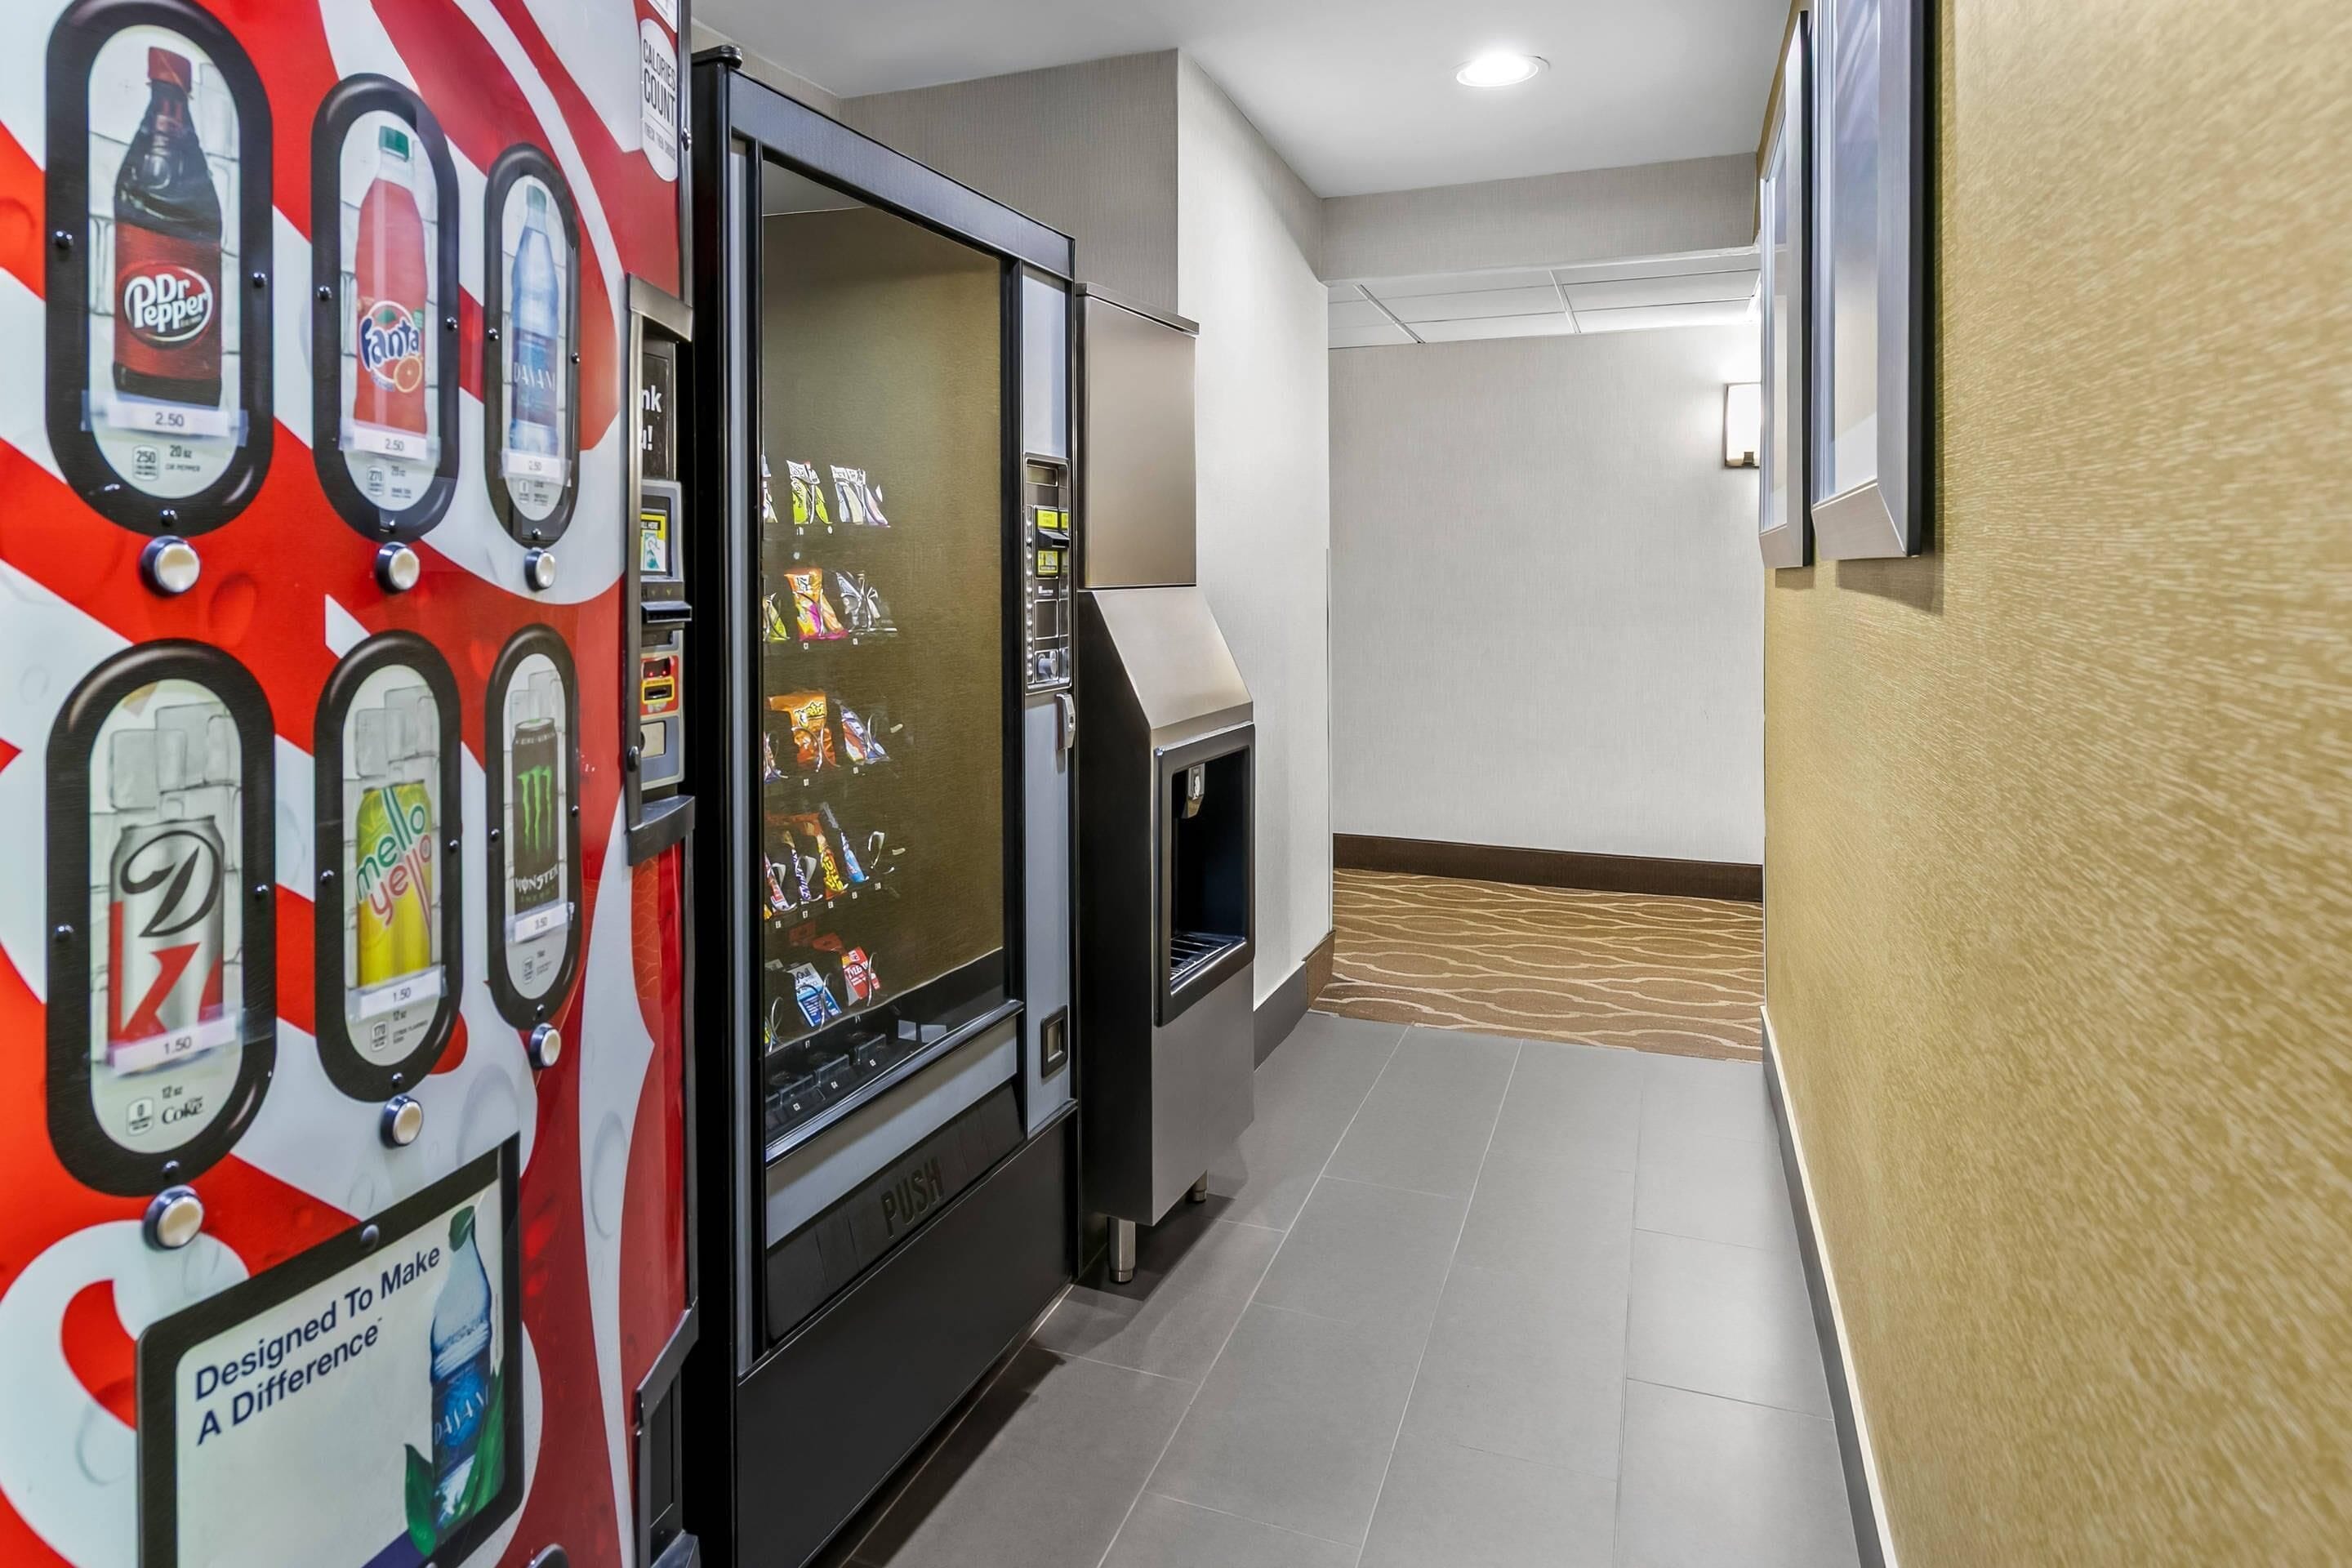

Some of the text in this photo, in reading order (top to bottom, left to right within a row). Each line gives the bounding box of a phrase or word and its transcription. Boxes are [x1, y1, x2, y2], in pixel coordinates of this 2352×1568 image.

[643, 38, 676, 91] CALORIES
[644, 67, 676, 127] COUNT
[124, 275, 209, 333] Pepper
[155, 273, 191, 304] Dr
[360, 315, 420, 372] Fanta
[154, 412, 185, 427] 2.50
[385, 438, 405, 452] 2.50
[136, 450, 157, 463] 250
[356, 786, 425, 901] mello
[370, 834, 432, 933] yello
[393, 987, 412, 1002] 1.50
[163, 1036, 192, 1054] 1.50
[161, 1101, 203, 1125] Coke
[880, 1156, 945, 1241] PUSH
[195, 1246, 441, 1401] Designed To Make
[196, 1322, 379, 1447] A Difference
